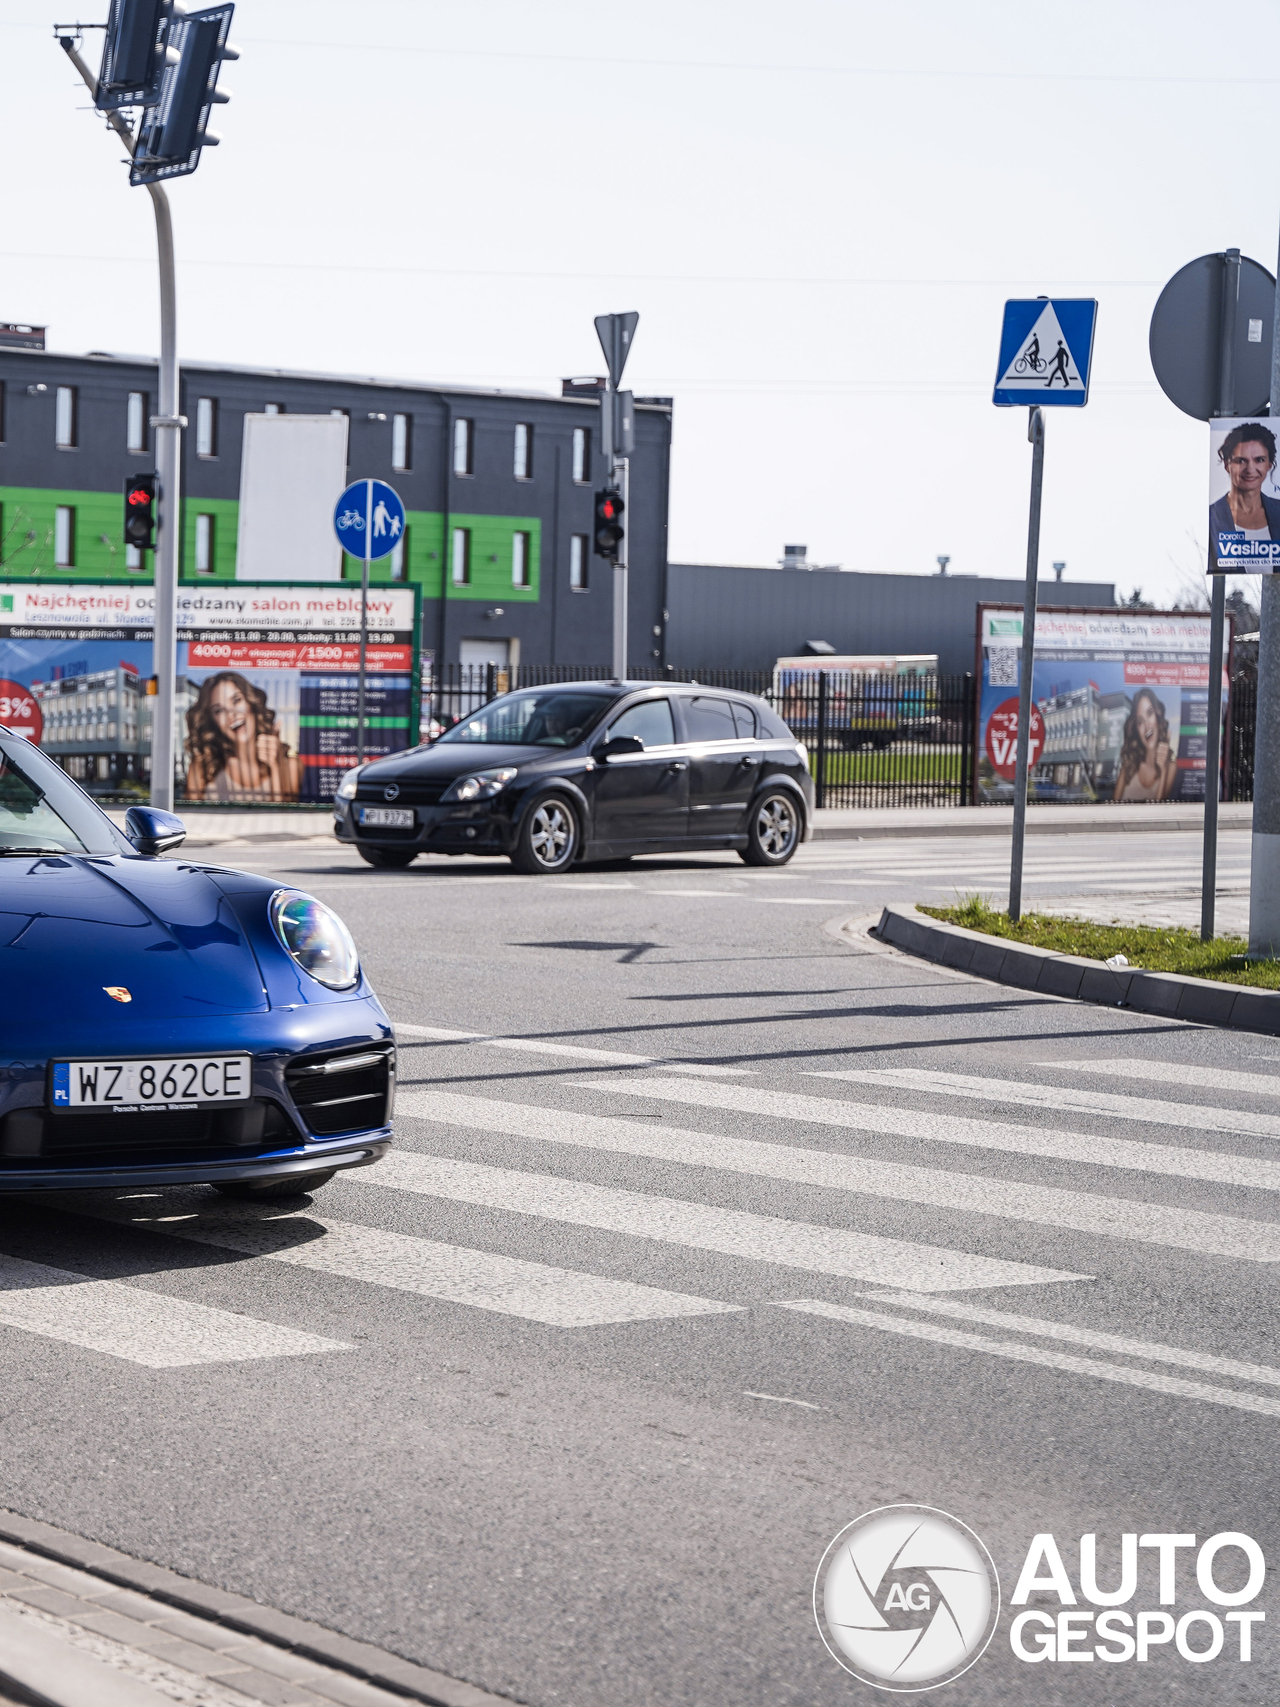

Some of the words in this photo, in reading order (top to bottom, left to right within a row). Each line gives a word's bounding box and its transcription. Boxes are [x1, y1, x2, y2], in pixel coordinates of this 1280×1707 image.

[1218, 532, 1245, 541] Dorota
[25, 594, 131, 612] Najchętniej
[251, 597, 300, 611] salon
[192, 644, 231, 658] 4000
[78, 1065, 123, 1102] WZ
[139, 1060, 241, 1100] 862CE
[55, 1089, 69, 1100] PL
